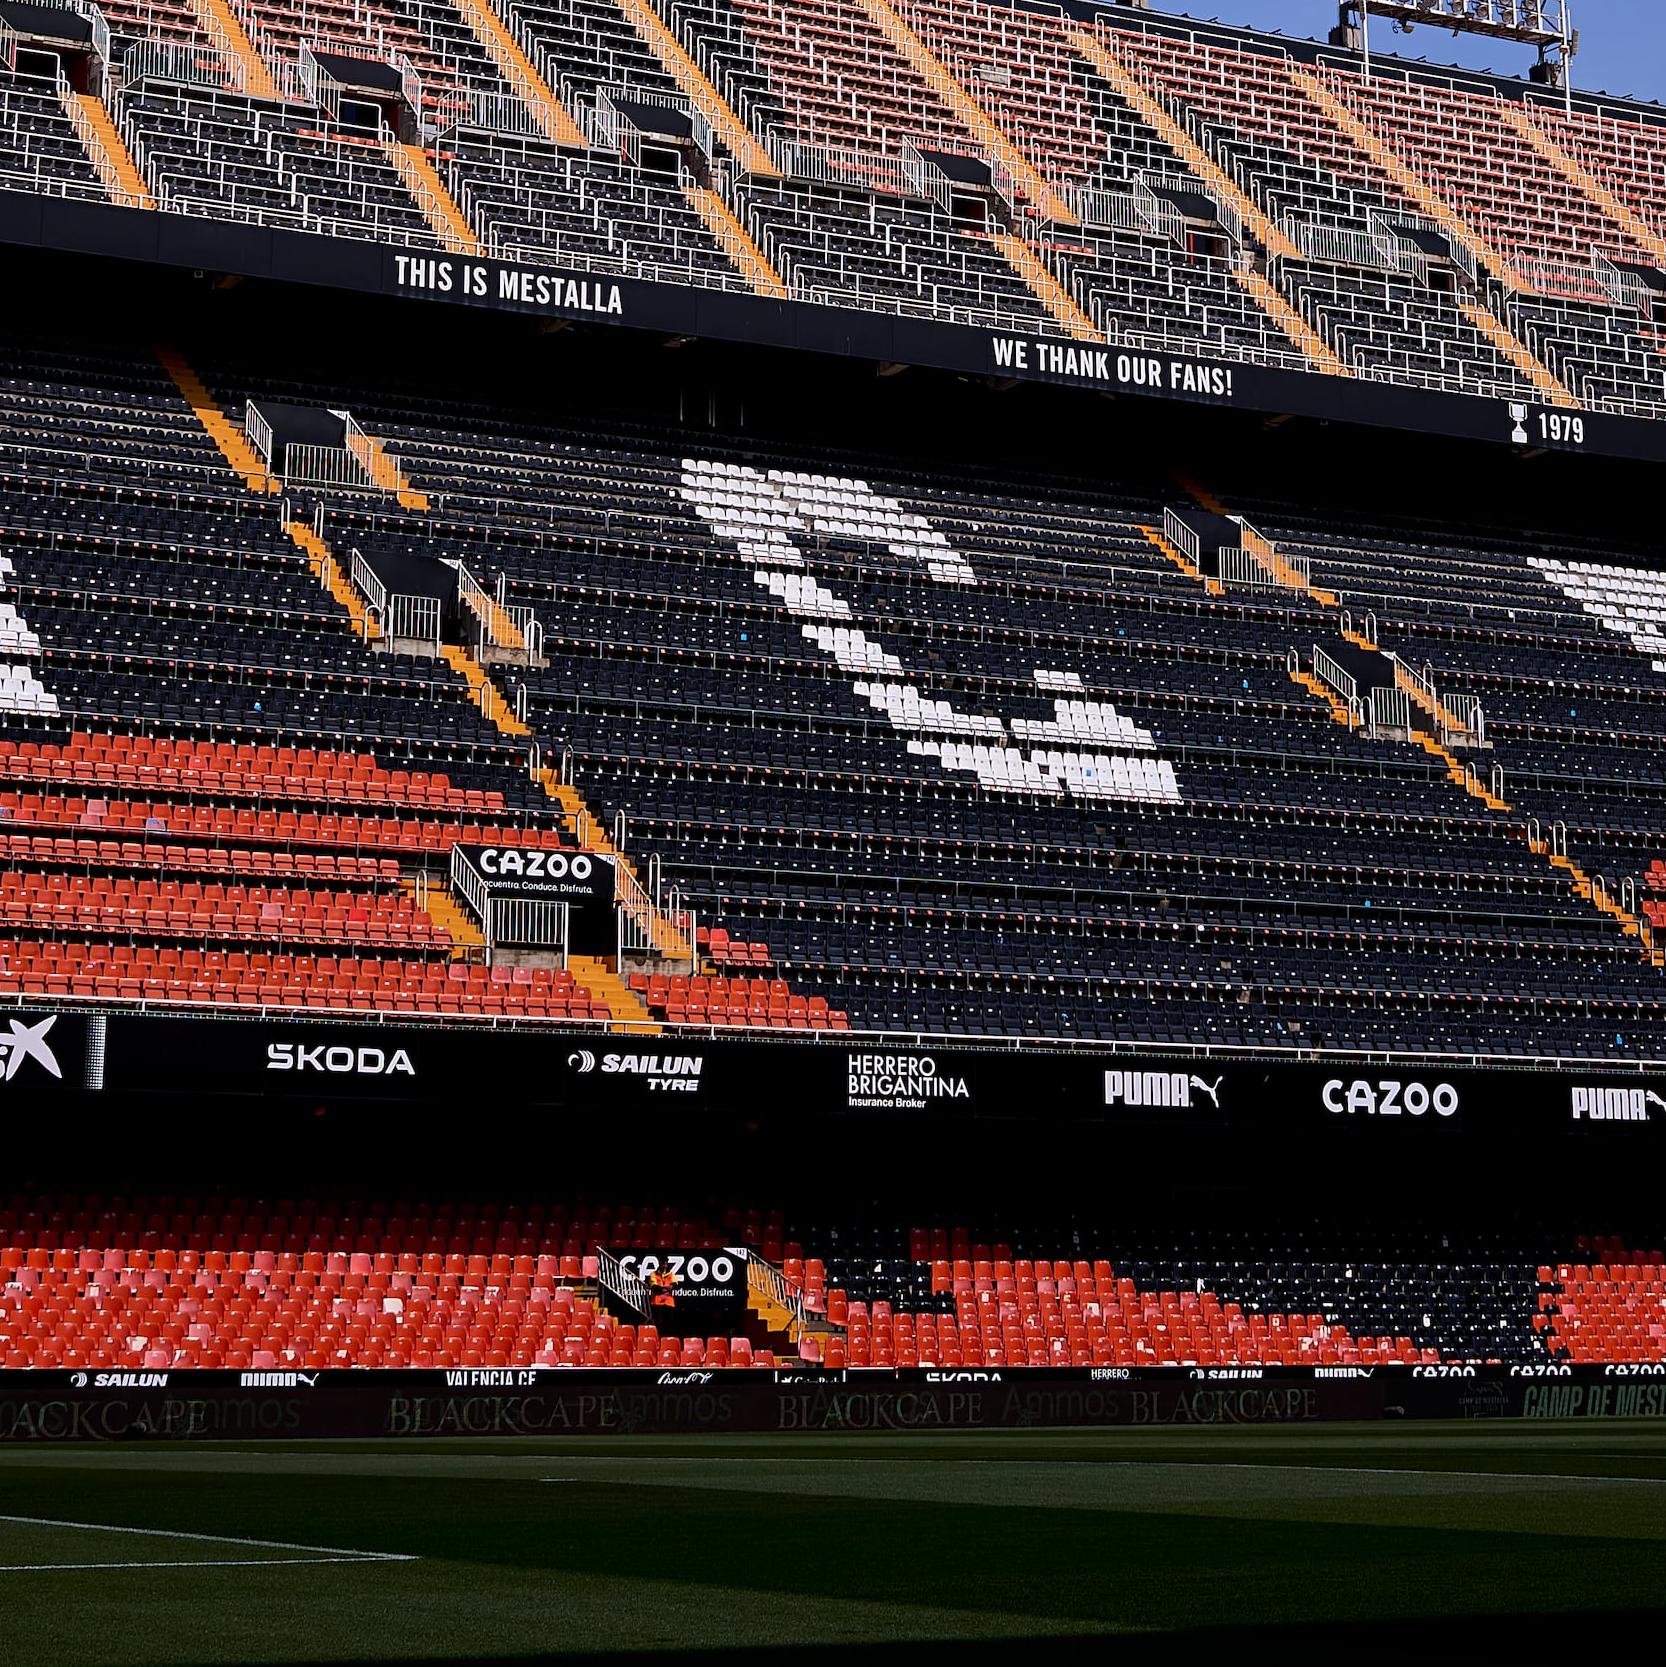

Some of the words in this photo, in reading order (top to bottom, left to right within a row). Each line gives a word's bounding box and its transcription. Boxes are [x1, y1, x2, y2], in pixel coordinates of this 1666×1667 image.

[395, 255, 453, 291] THIS
[463, 266, 488, 296] IS
[499, 270, 623, 315] MESTALLA
[993, 337, 1028, 370] WE
[1036, 343, 1109, 380] THANK
[1117, 354, 1162, 387] OUR
[1171, 362, 1232, 397] FANS!
[1538, 412, 1584, 444] 1979
[479, 848, 593, 880] CAZOO
[521, 883, 559, 893] Conduce.
[560, 885, 593, 894] Disfruta.
[601, 1054, 703, 1075] SAILUN
[848, 1054, 936, 1077] HERRERO
[647, 1078, 699, 1092] TYRE
[848, 1074, 970, 1098] BRIGANTINA
[1104, 1070, 1190, 1108] PUMA
[1322, 1079, 1459, 1117] CAZOO
[848, 1096, 894, 1108] Insurance
[895, 1098, 927, 1109] Broker
[1571, 1087, 1647, 1121] PUMA
[620, 1255, 734, 1283] CAZOO
[93, 1375, 169, 1388] SAILUN
[1091, 1368, 1130, 1378] HERRERO
[1523, 1384, 1585, 1418] CAMP
[1589, 1384, 1614, 1417] DE
